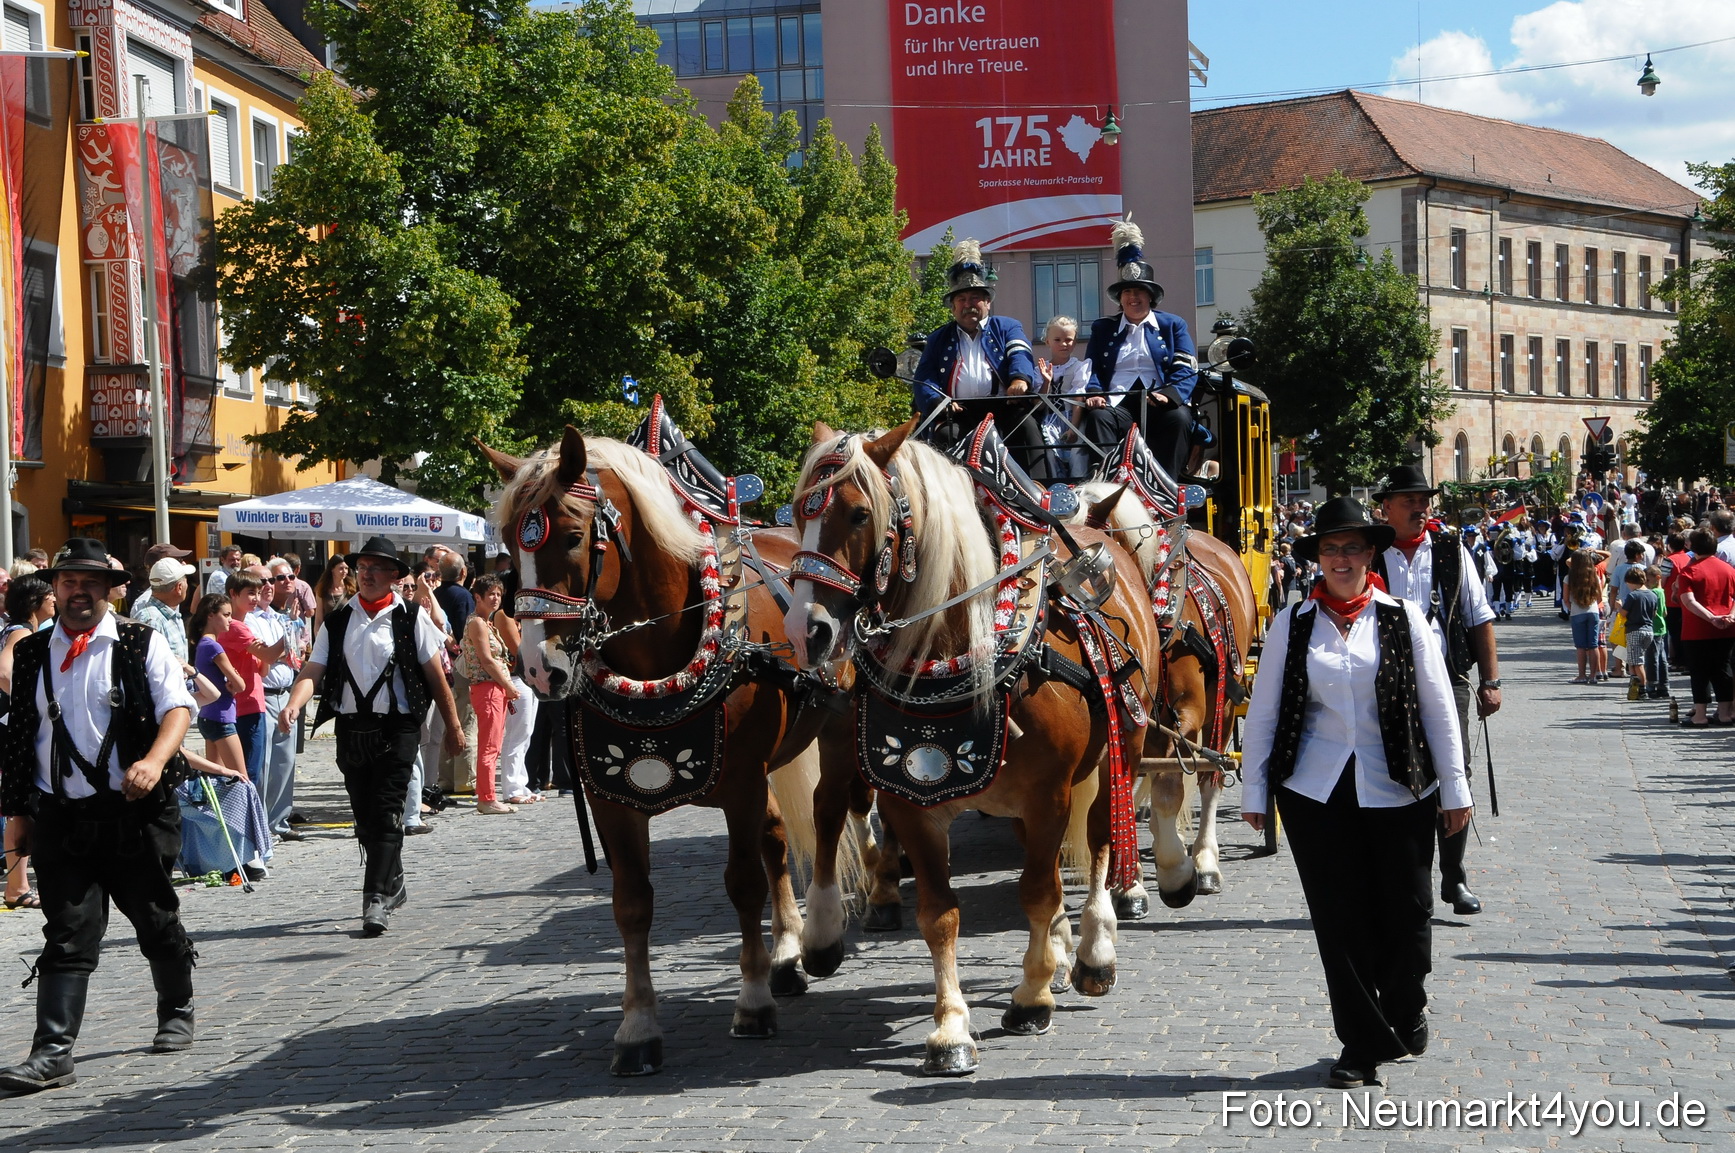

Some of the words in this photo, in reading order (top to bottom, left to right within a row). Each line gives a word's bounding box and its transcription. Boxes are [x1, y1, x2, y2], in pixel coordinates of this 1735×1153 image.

[904, 0, 986, 26] Danke
[904, 39, 929, 54] für
[932, 37, 955, 53] Ihr
[958, 35, 1040, 52] Vertrauen
[906, 61, 937, 77] und
[942, 59, 974, 75] Ihre
[977, 58, 1029, 74] Treue.
[975, 114, 1051, 148] 175
[978, 147, 1052, 169] JAHRE
[978, 177, 1022, 189] Sparkasse
[1023, 175, 1104, 187] Neumarkt-Parsberg
[235, 510, 280, 524] Winkler
[282, 511, 308, 524] Bräu
[355, 513, 400, 527] Winkler
[402, 514, 428, 528] Bräu
